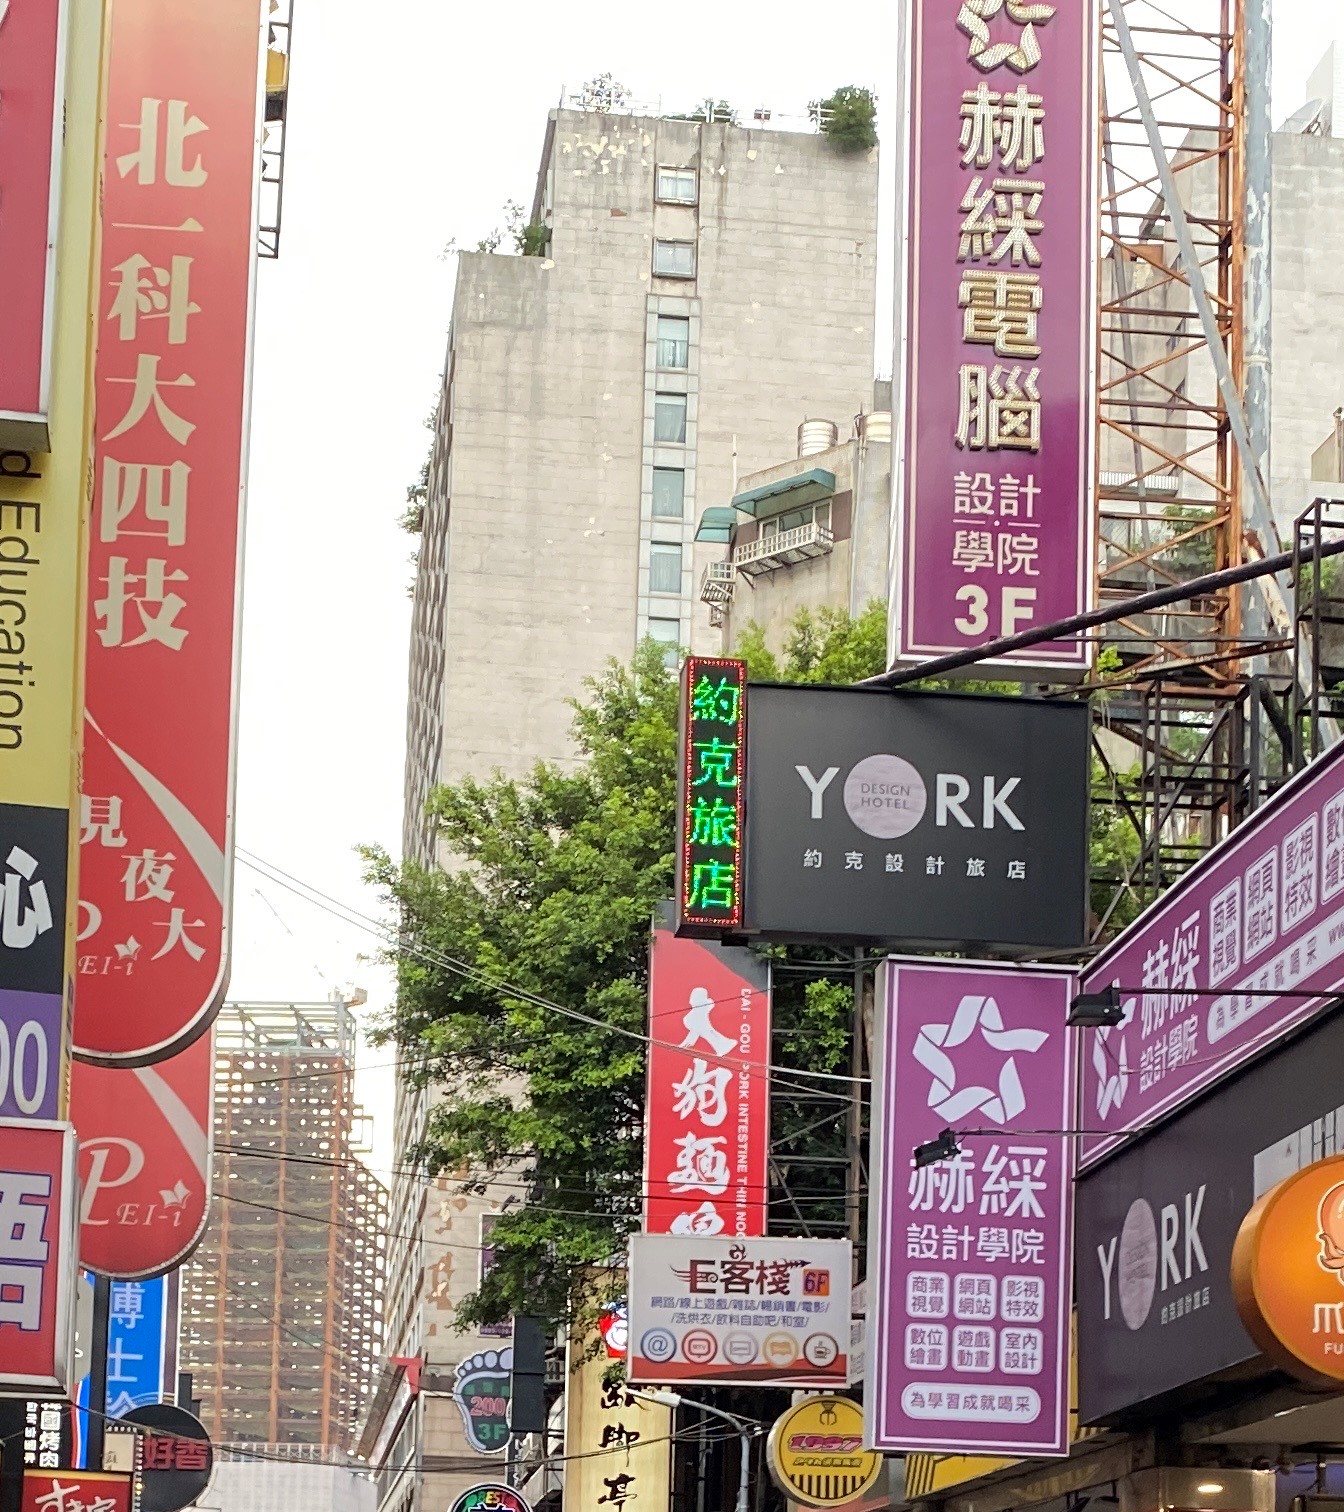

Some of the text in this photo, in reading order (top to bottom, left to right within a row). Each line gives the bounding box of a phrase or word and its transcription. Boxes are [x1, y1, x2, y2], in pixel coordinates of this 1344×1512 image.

[954, 81, 1046, 453] 赫綵電腦
[94, 98, 211, 653] 北一科大四技
[953, 471, 1042, 519] 設計
[952, 529, 1040, 578] 學院
[954, 583, 1038, 639] 3F
[688, 674, 741, 911] 約克旅店
[860, 781, 911, 797] DESIGN
[860, 794, 911, 811] HOTEL
[803, 848, 1027, 881] 約克設計旅店
[1139, 909, 1201, 1041] 赫綵
[1138, 1014, 1199, 1095] 設計學院
[735, 1103, 749, 1174] INTESTINE
[735, 1177, 748, 1208] THIN
[907, 1144, 1048, 1219] 赫綵
[906, 1223, 1046, 1264] 設計學院
[805, 1271, 829, 1294] 6F
[911, 1275, 945, 1294] 商業
[1007, 1279, 1040, 1299] 影視
[1006, 1299, 1040, 1319] 特效
[1005, 1332, 1038, 1351] 室內
[1005, 1351, 1038, 1371] 設計
[469, 1396, 506, 1417] 200
[909, 1390, 1032, 1413] 為學習成就喝采
[477, 1424, 507, 1441] 3F
